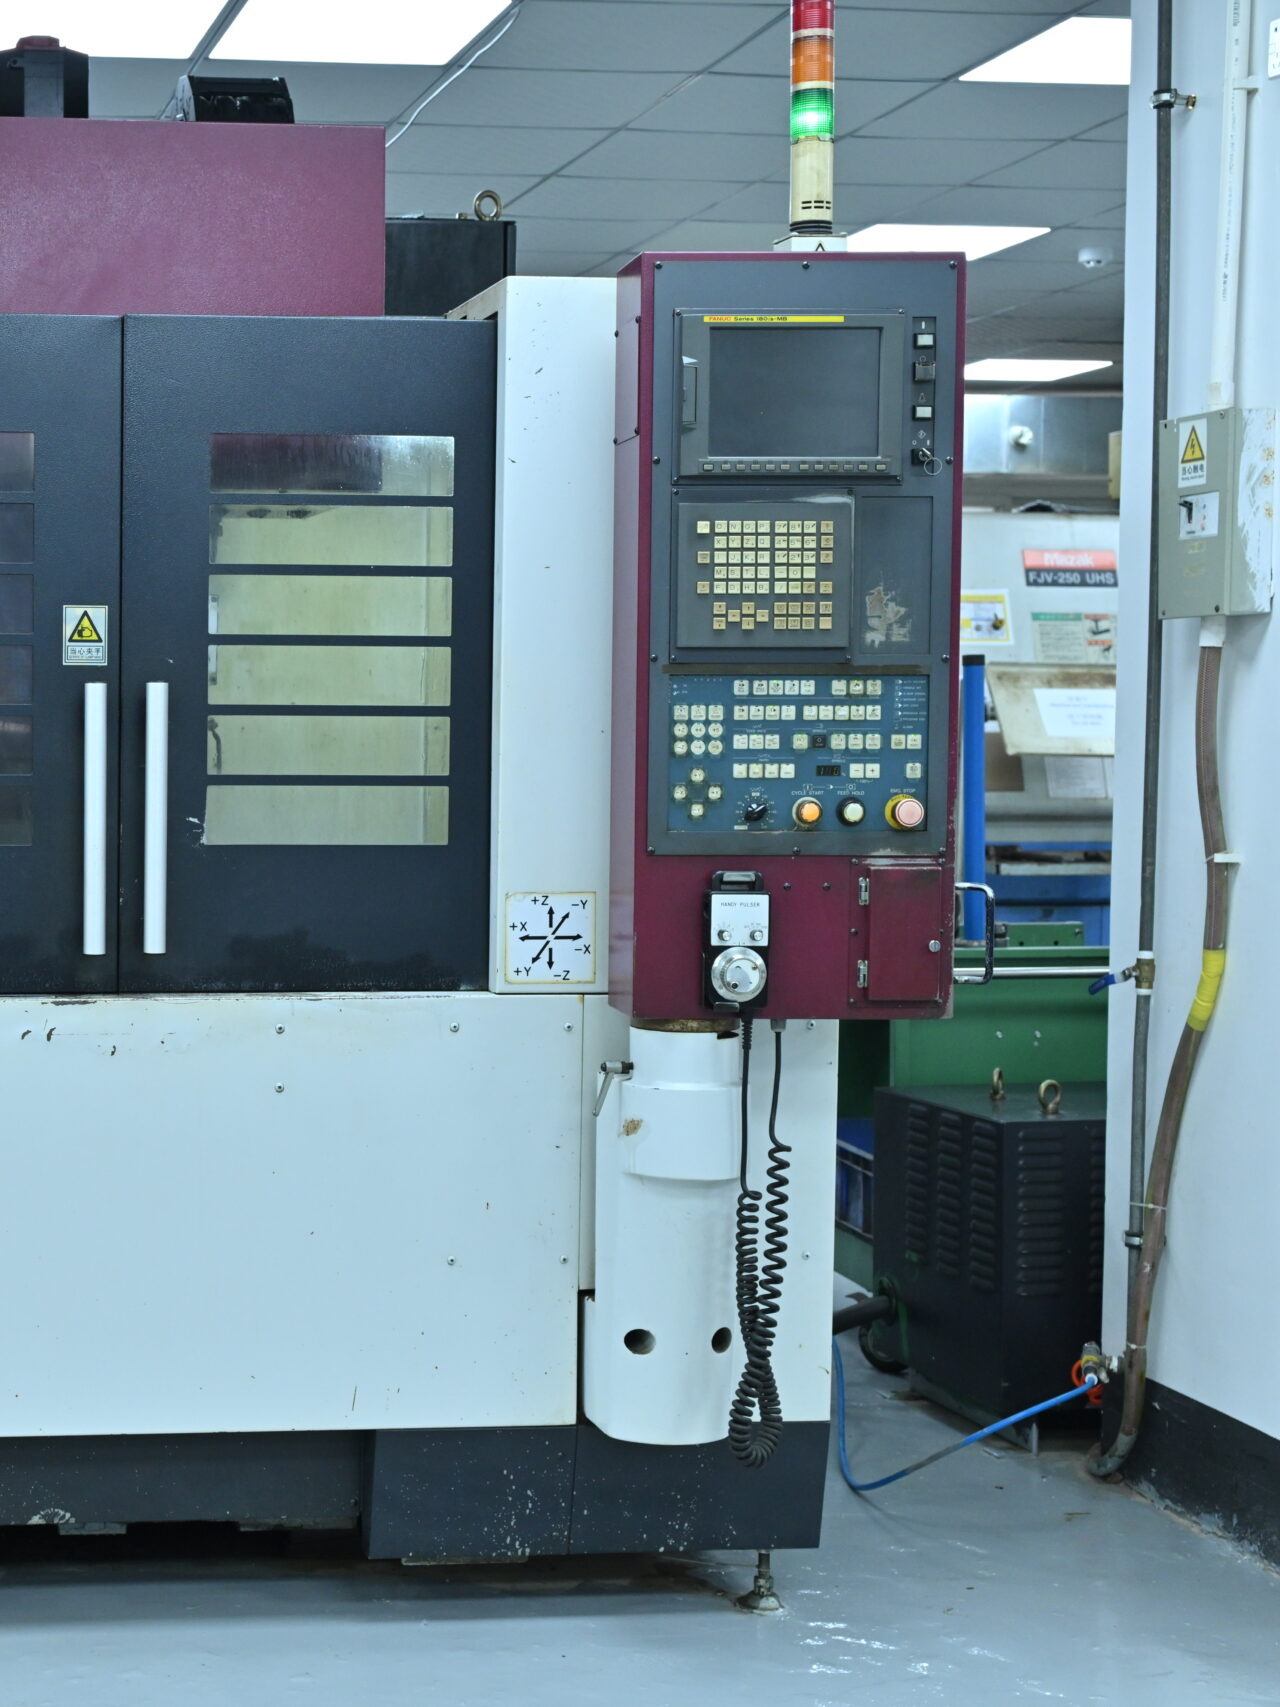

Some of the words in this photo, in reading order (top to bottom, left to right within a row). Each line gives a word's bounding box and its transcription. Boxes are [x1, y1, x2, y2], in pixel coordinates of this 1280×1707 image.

[1044, 552, 1094, 567] Mazak
[1028, 571, 1080, 584] FJV-250
[1086, 571, 1115, 584] UHS
[531, 895, 549, 906] +Z
[571, 899, 588, 910] -Y
[509, 921, 528, 931] +X
[574, 944, 591, 954] -X
[513, 966, 531, 976] +Y
[553, 970, 570, 980] -Z
